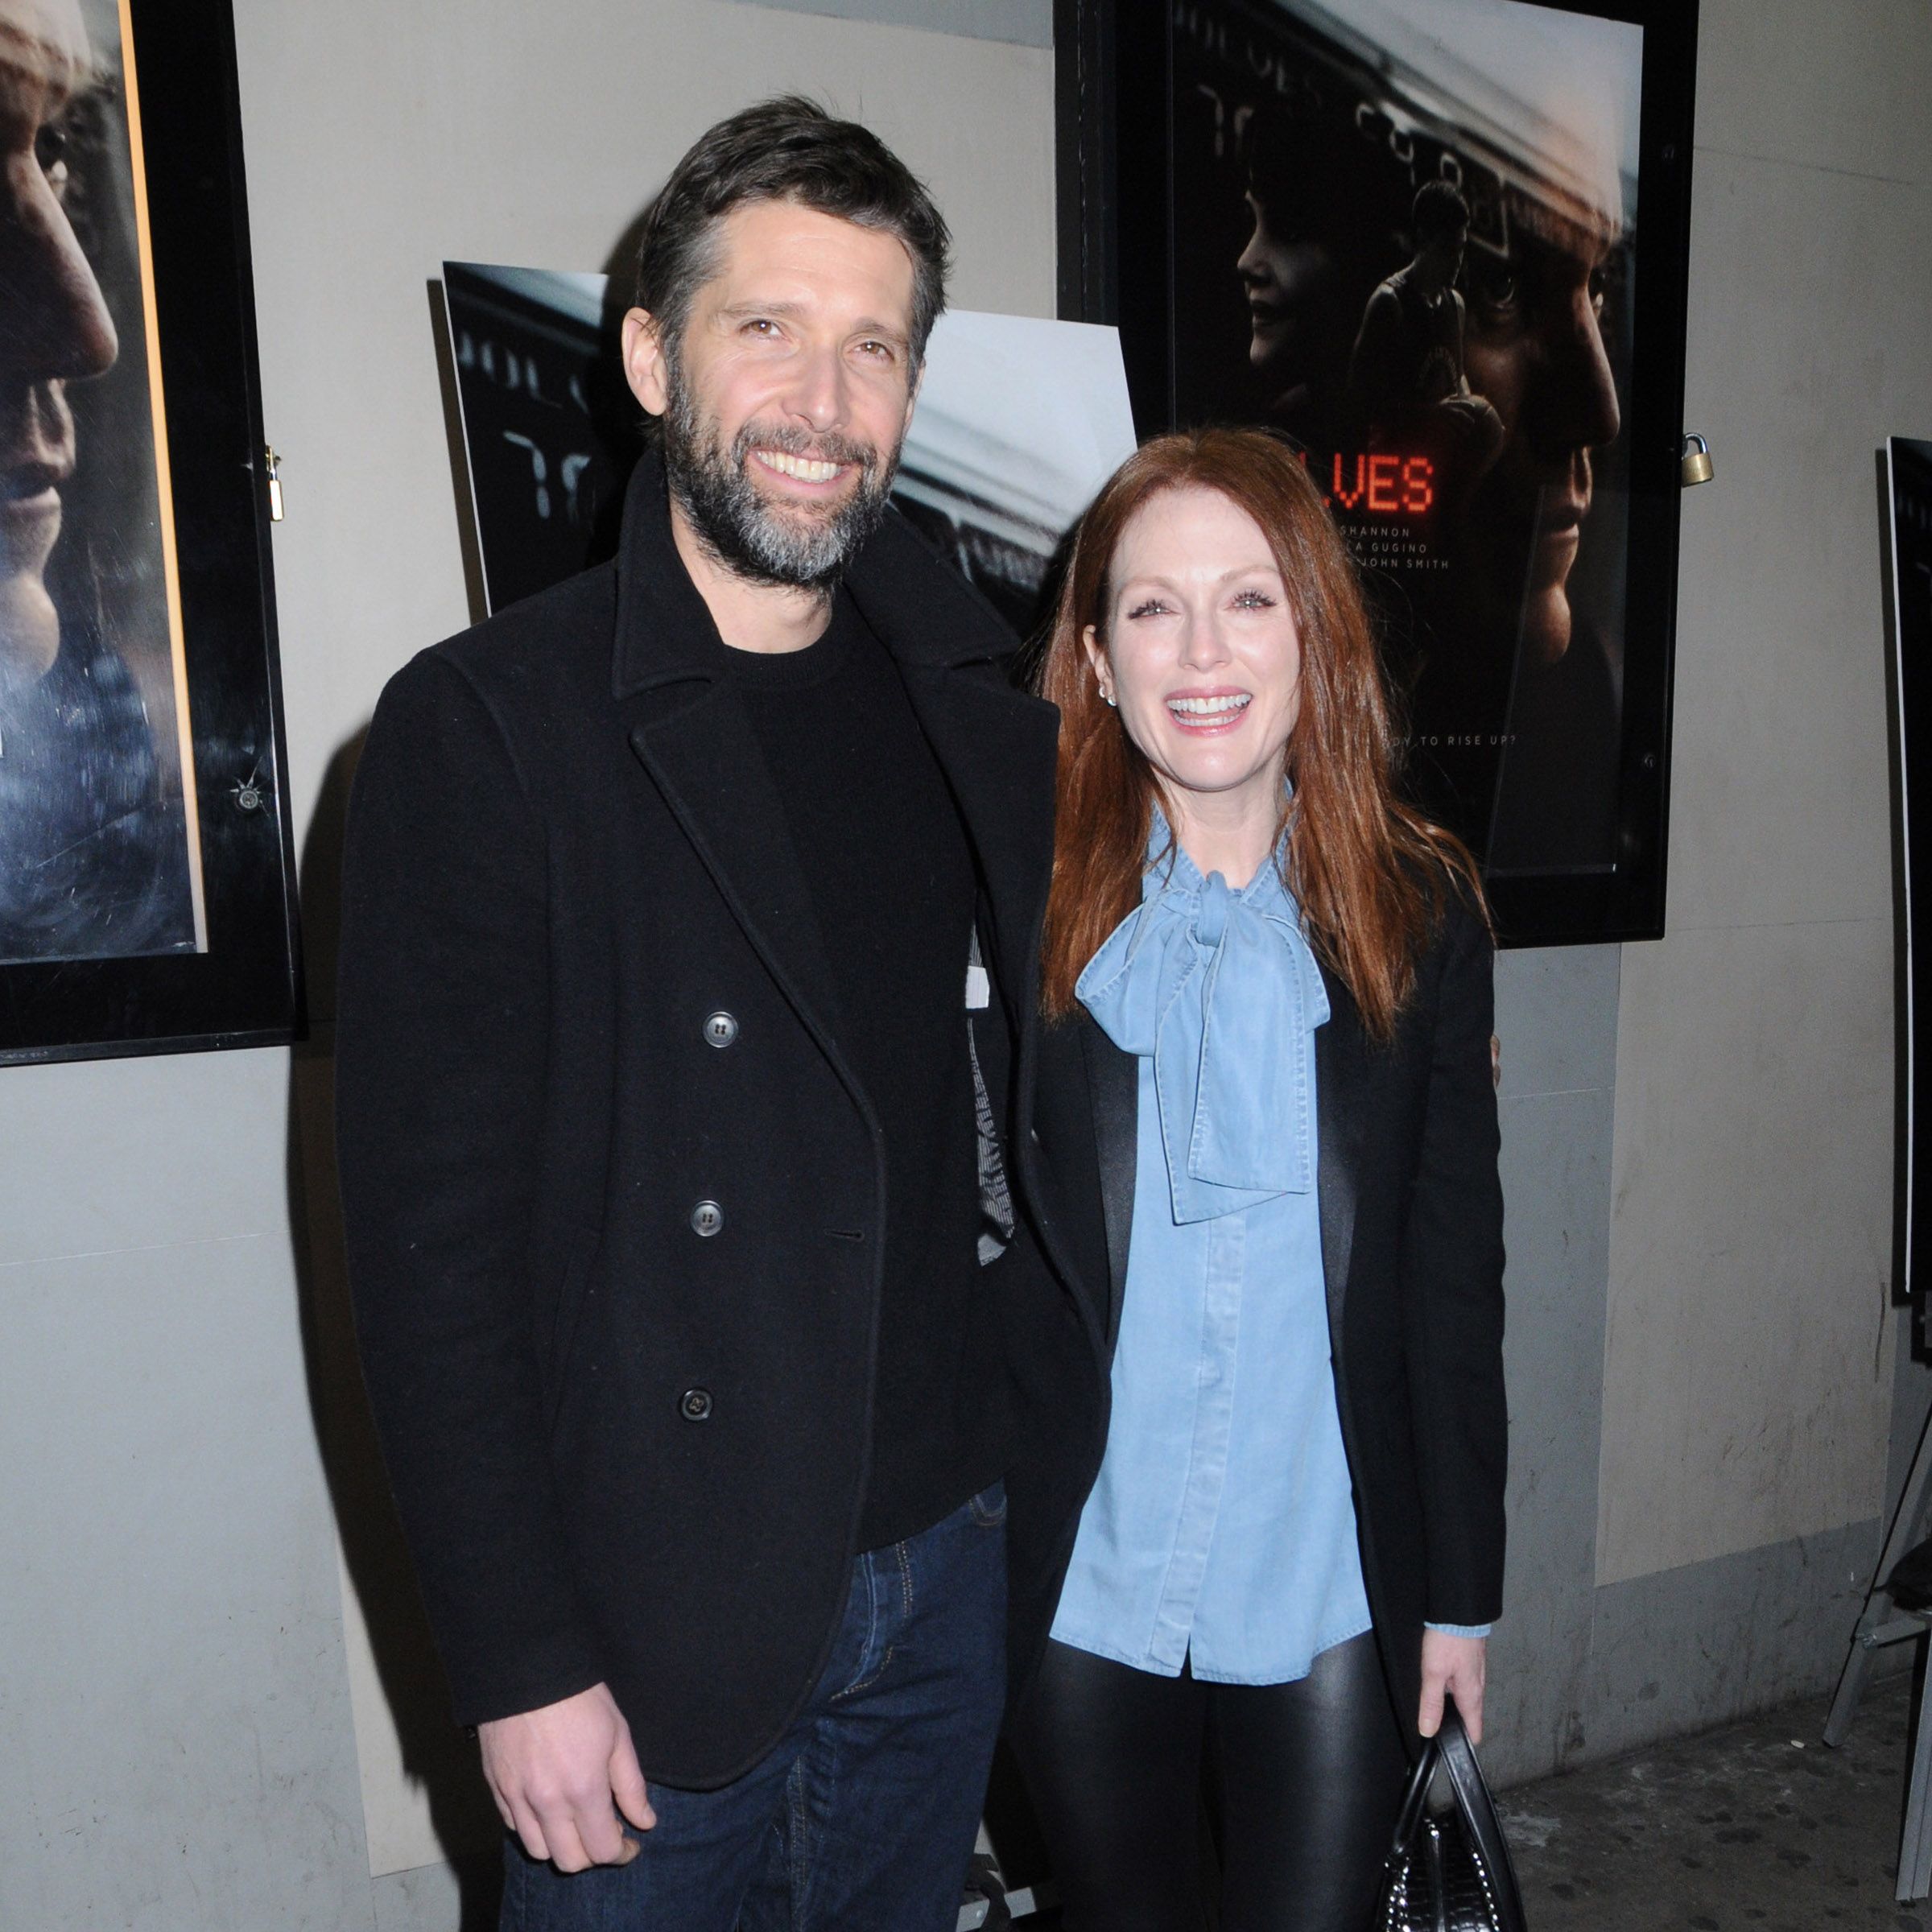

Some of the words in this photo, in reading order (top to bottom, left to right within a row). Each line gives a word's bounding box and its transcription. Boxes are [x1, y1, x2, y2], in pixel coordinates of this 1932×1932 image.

[1299, 450, 1435, 512] VES
[1340, 525, 1410, 538] SHANNON
[1371, 542, 1427, 554] GUGINO
[1362, 557, 1399, 568] JOHN
[1406, 559, 1449, 570] SMITH
[1420, 736, 1439, 746] TO
[1447, 735, 1482, 746] RISE
[1489, 734, 1517, 746] UP?
